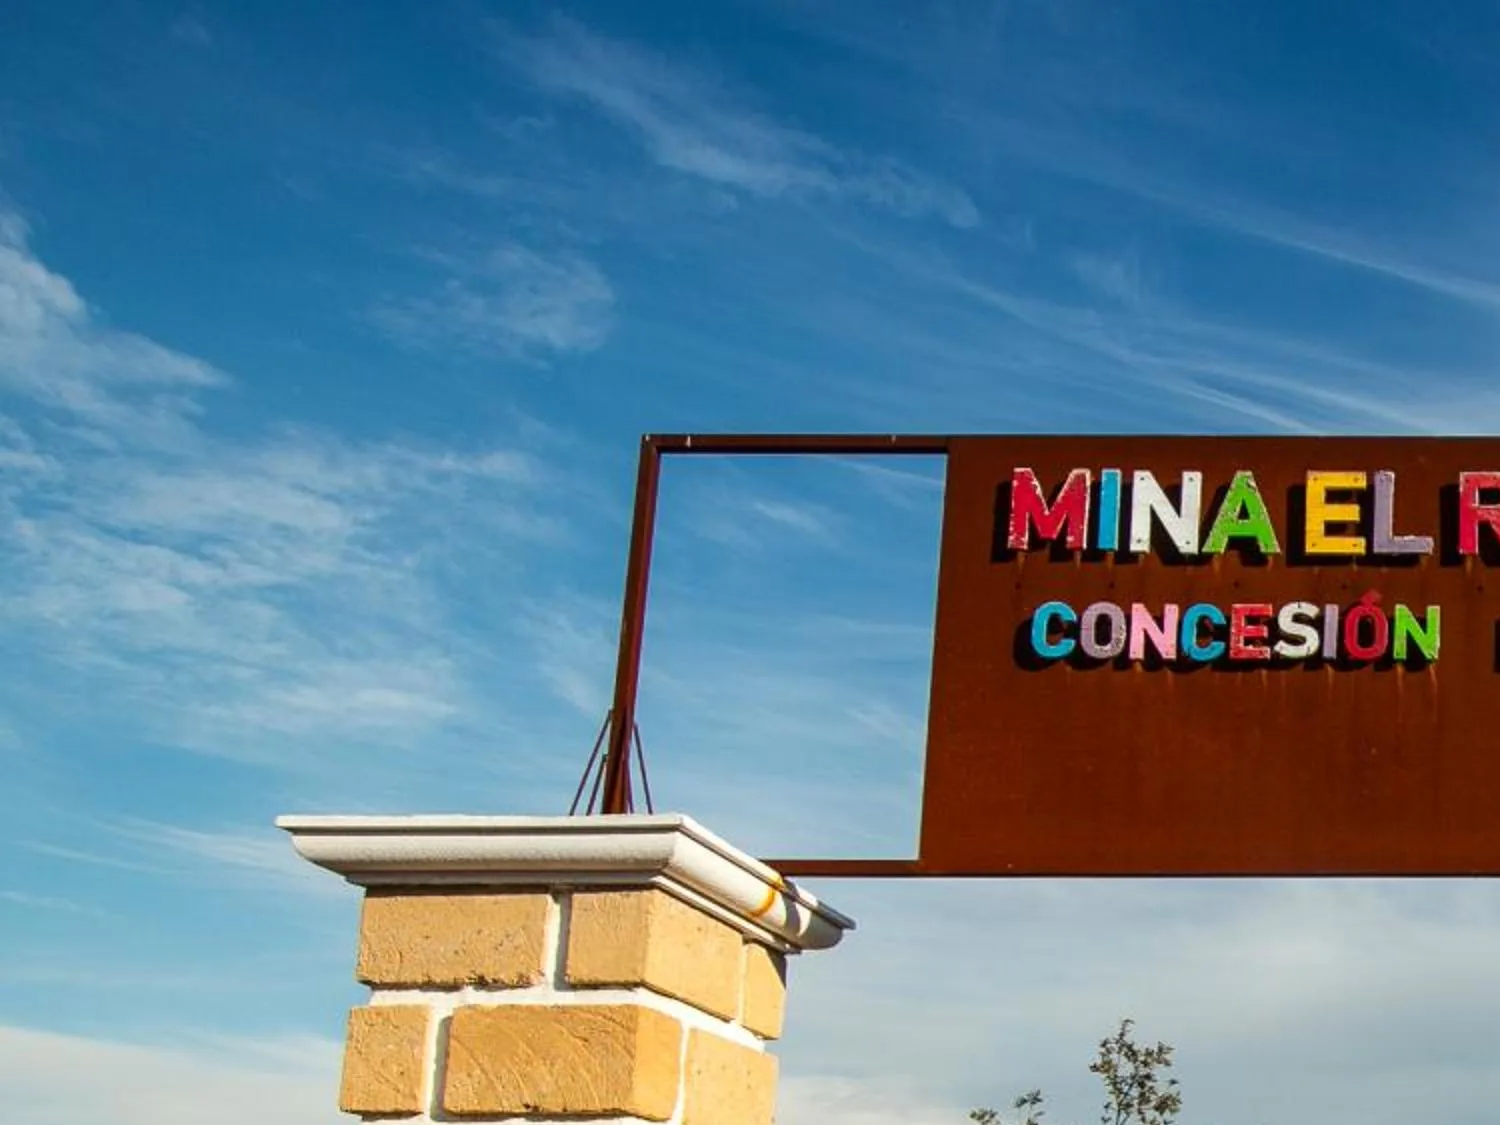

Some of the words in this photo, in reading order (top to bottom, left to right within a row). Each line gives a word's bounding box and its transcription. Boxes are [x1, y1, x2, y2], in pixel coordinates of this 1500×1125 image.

[1008, 467, 1281, 555] MINA
[1305, 470, 1434, 555] EL
[1031, 589, 1440, 662] CONCESIÓN
